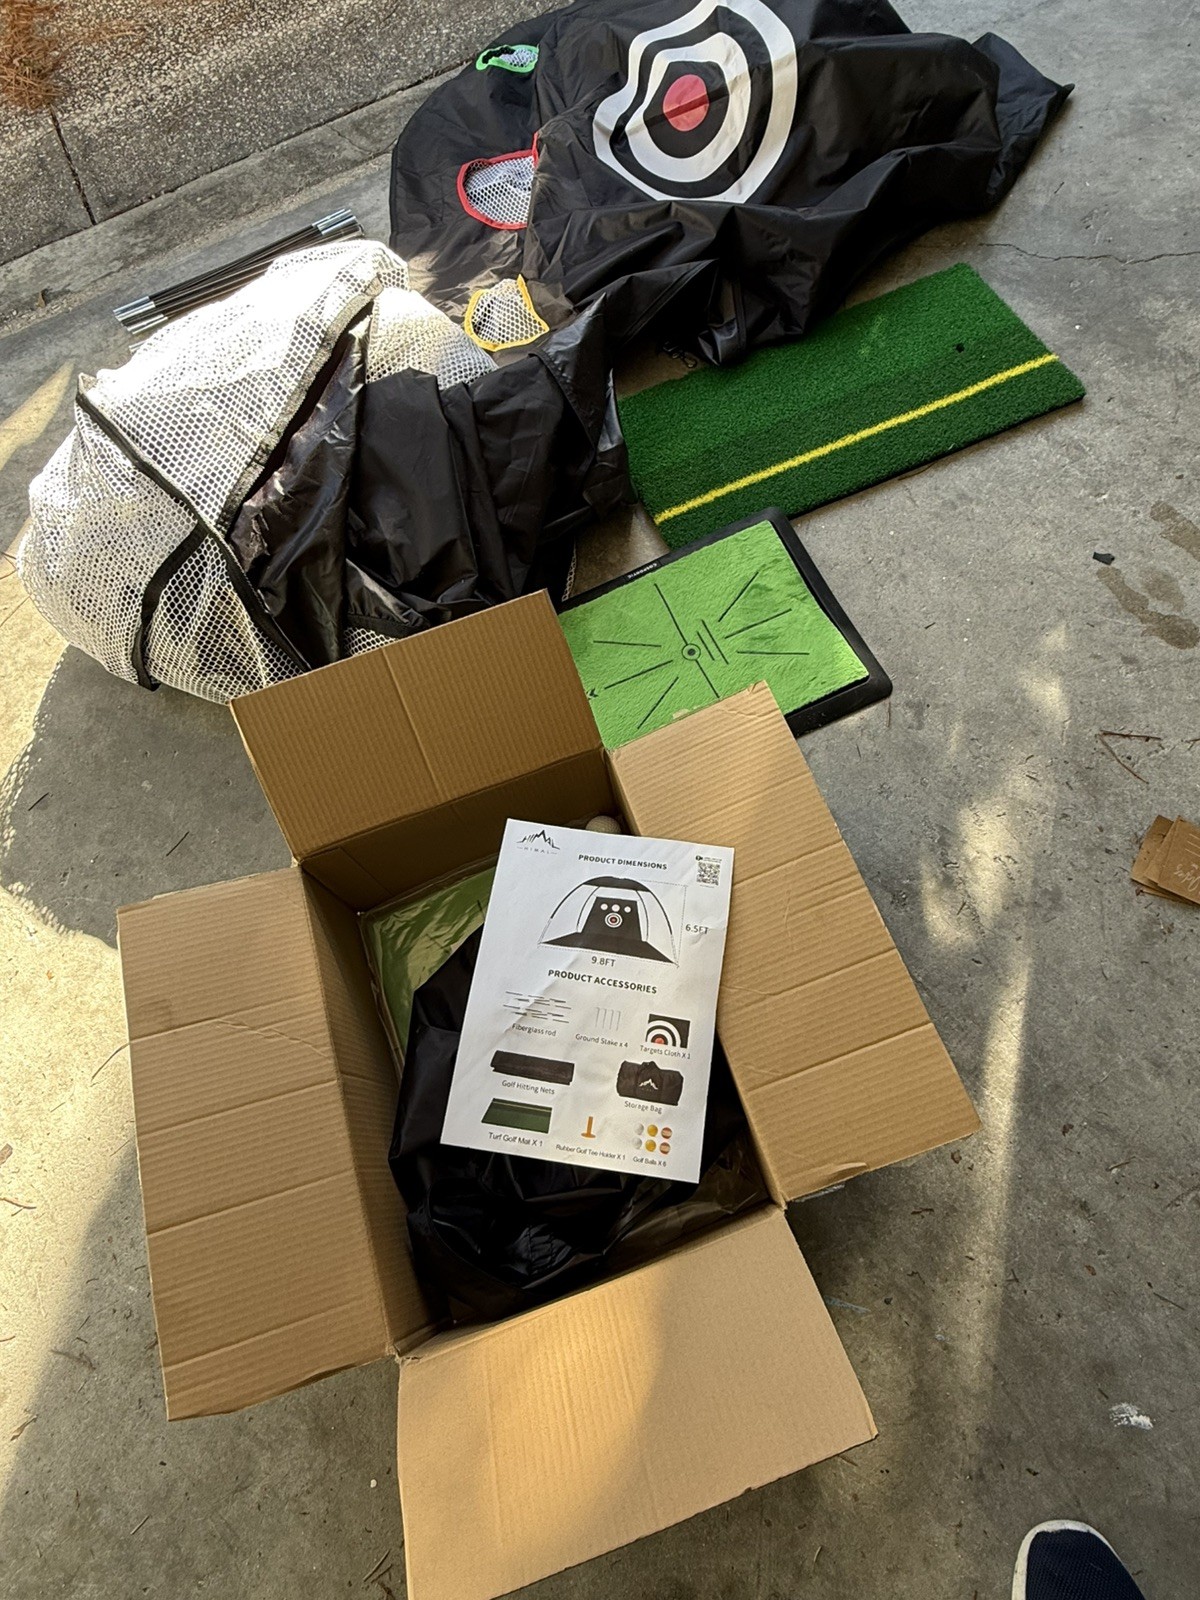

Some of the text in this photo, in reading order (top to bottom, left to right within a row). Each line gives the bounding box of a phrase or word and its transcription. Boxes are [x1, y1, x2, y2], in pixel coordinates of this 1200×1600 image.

[578, 854, 668, 870] PRODUCT DIMENSIONS
[685, 923, 709, 935] 6.5FT
[591, 955, 616, 967] 9.8FT
[548, 969, 657, 994] PRODUCT ACCESSORIES
[511, 1022, 556, 1037] Fiberglass rod
[575, 1033, 600, 1044] Ground
[600, 1037, 618, 1047] Stake
[640, 1044, 663, 1056] Targets
[664, 1049, 681, 1057] Cloth
[501, 1079, 555, 1095] Golf Hitting Nets
[624, 1100, 663, 1115] Storage Bag
[488, 1131, 502, 1140] Turf
[502, 1134, 518, 1142] Golf
[517, 1136, 531, 1145] Mat
[531, 1139, 538, 1147] X
[556, 1143, 575, 1152] Rubber
[575, 1147, 588, 1155] Golf
[588, 1149, 599, 1157] Tee
[599, 1150, 616, 1159] Holder
[632, 1155, 645, 1164] Golf
[644, 1158, 658, 1166] Balls
